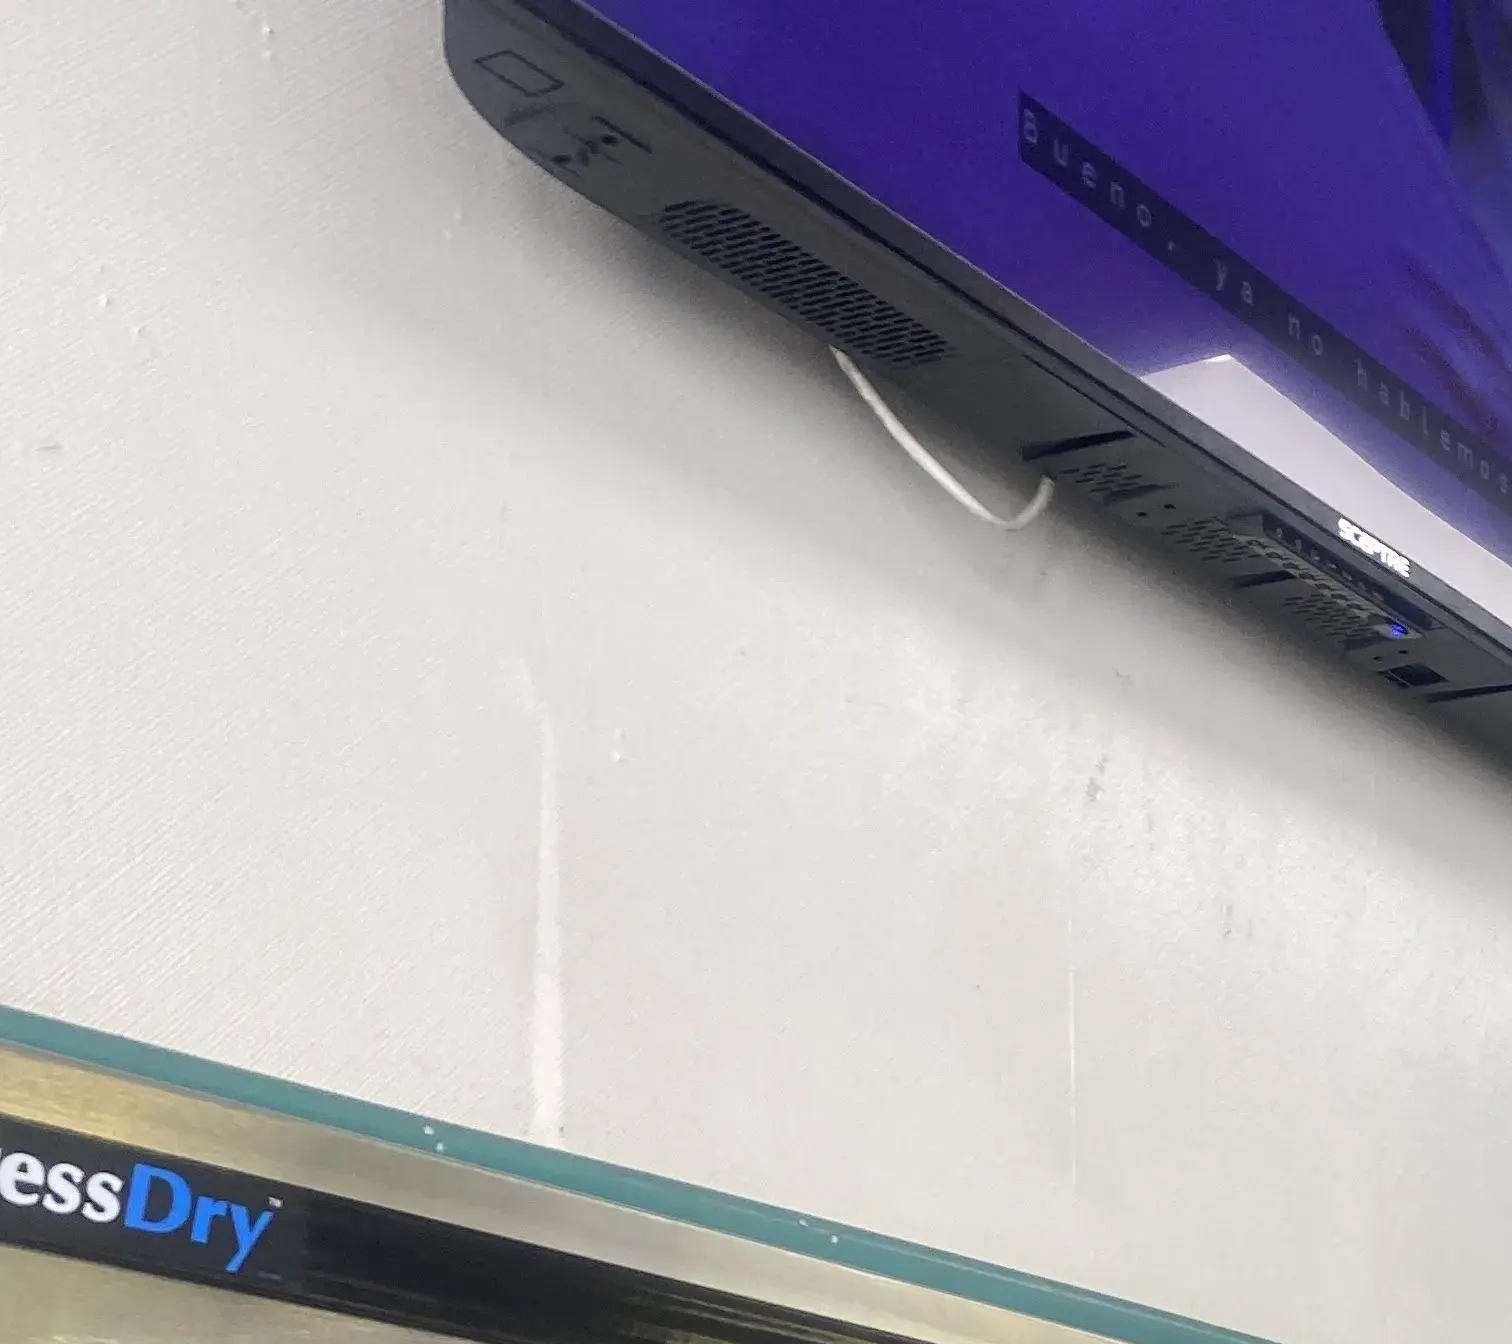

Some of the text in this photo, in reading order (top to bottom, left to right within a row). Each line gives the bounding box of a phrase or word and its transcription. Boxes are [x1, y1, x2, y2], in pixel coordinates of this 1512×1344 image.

[1214, 258, 1254, 307] ya
[1287, 313, 1323, 356] no
[1337, 517, 1411, 578] SCEPTRE
[0, 1147, 273, 1273] essDry
